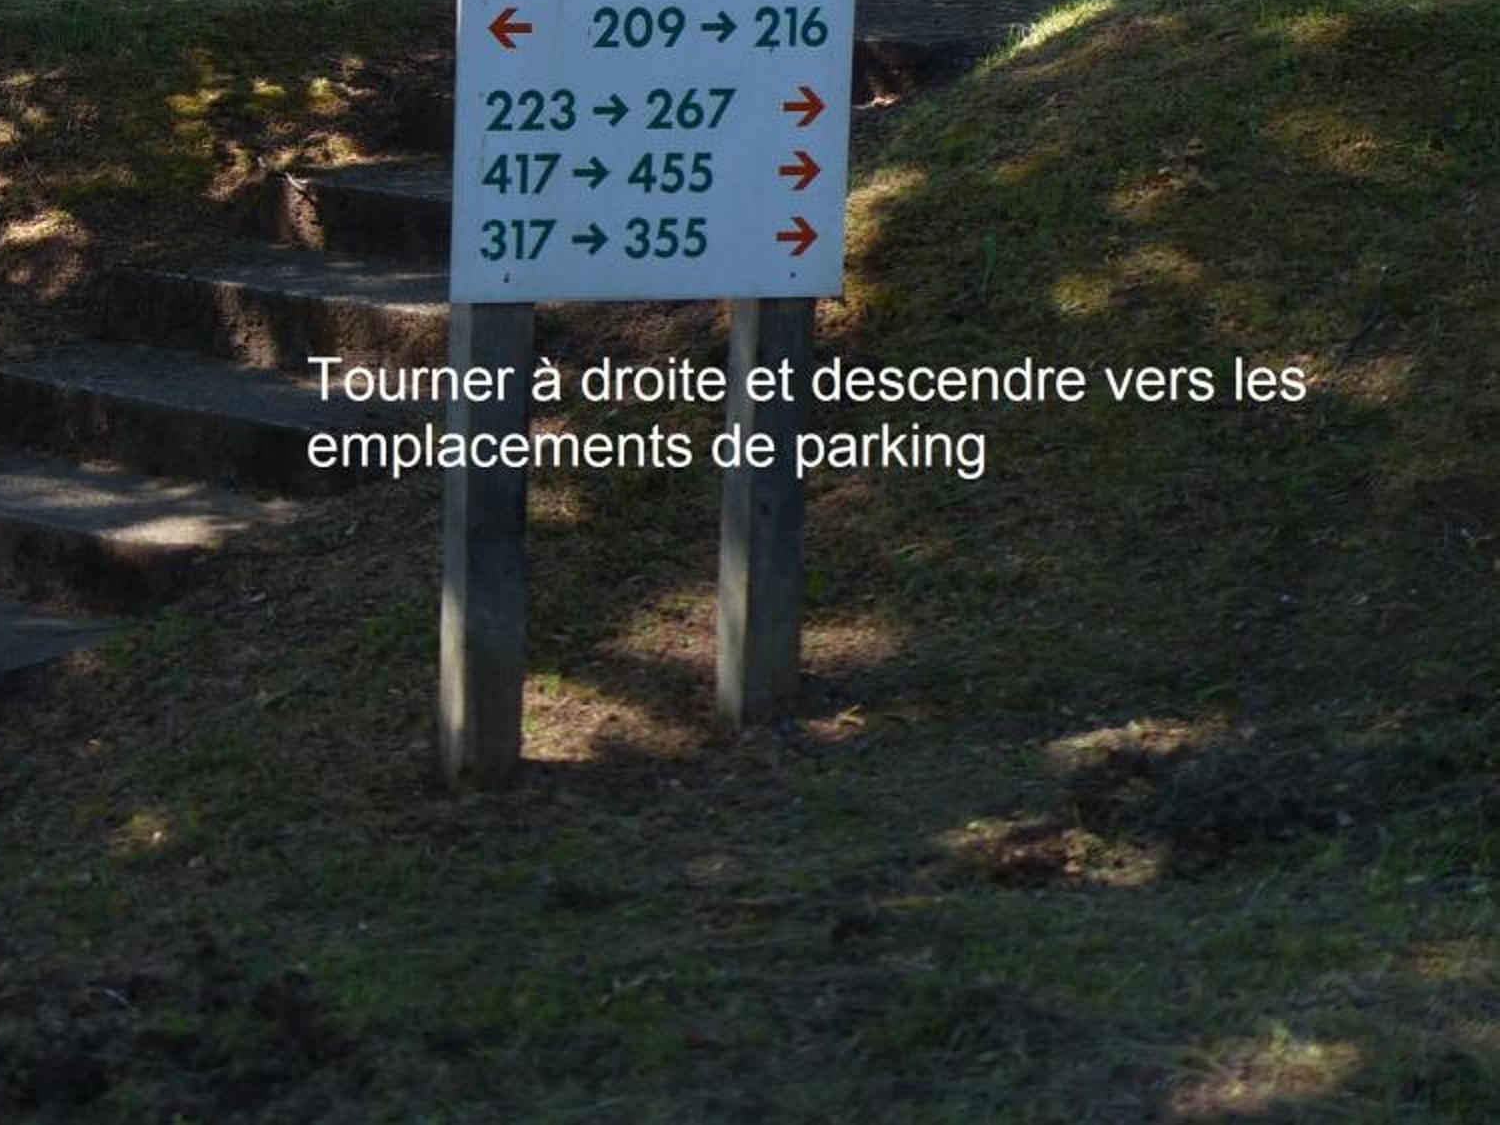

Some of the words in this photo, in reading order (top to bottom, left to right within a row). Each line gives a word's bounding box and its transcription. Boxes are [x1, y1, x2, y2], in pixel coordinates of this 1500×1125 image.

[592, 5, 686, 49] 209
[754, 5, 829, 48] 216
[485, 88, 577, 132] 223
[645, 87, 738, 131] 267
[480, 152, 562, 196] 417
[627, 151, 713, 194] 455
[480, 218, 557, 261] 317
[624, 216, 707, 260] 355
